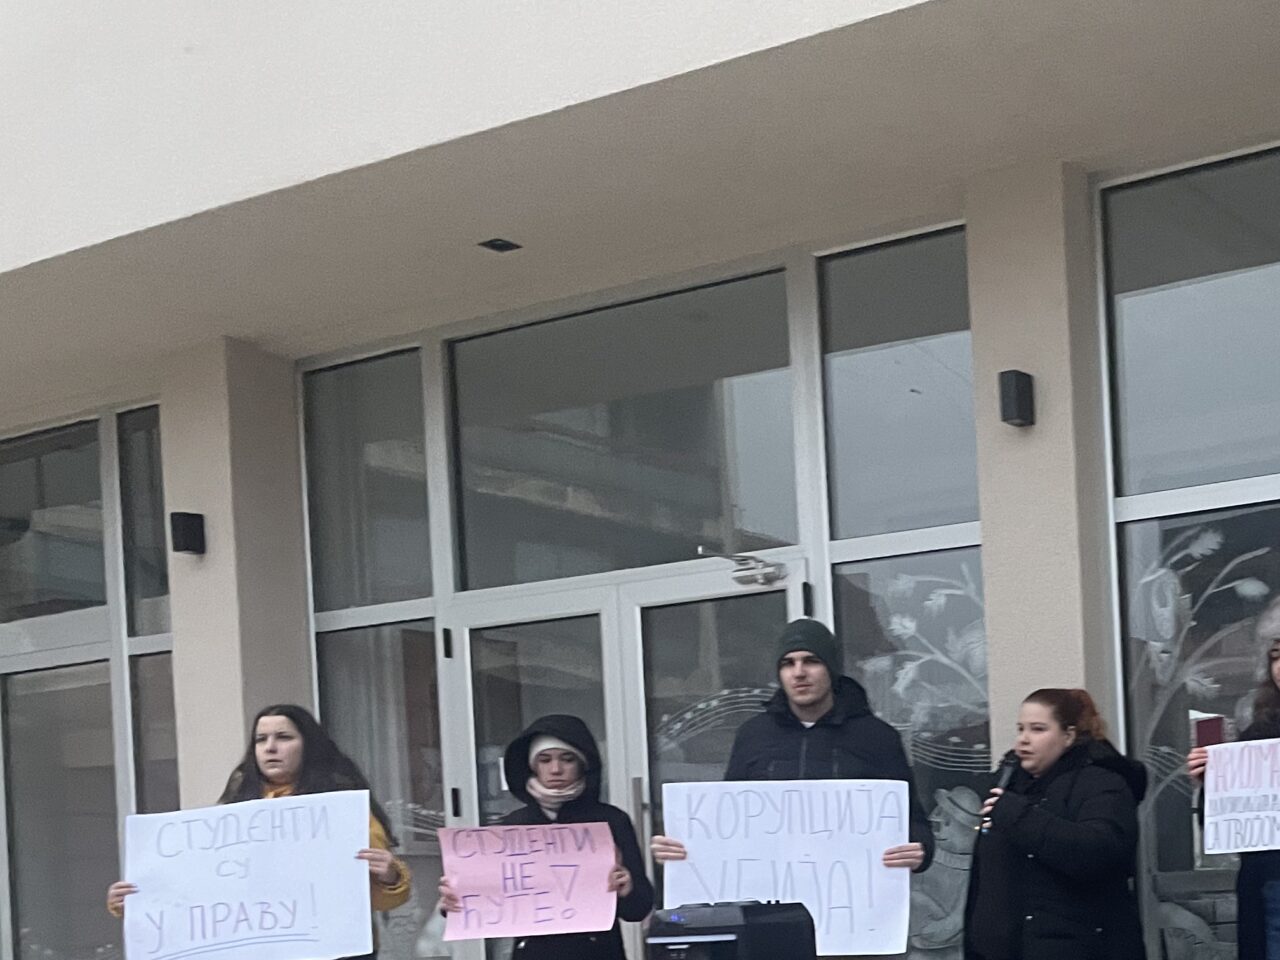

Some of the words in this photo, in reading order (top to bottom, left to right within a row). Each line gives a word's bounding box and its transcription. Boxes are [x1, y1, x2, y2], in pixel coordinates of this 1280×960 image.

[156, 805, 329, 857] СТУДЕНТИ
[686, 784, 903, 839] КОРУПЦИЈА
[452, 826, 597, 858] СТУДЕНТИ
[503, 862, 536, 893] НЕ
[145, 910, 165, 954] У
[189, 882, 319, 942] ПРАВУ!
